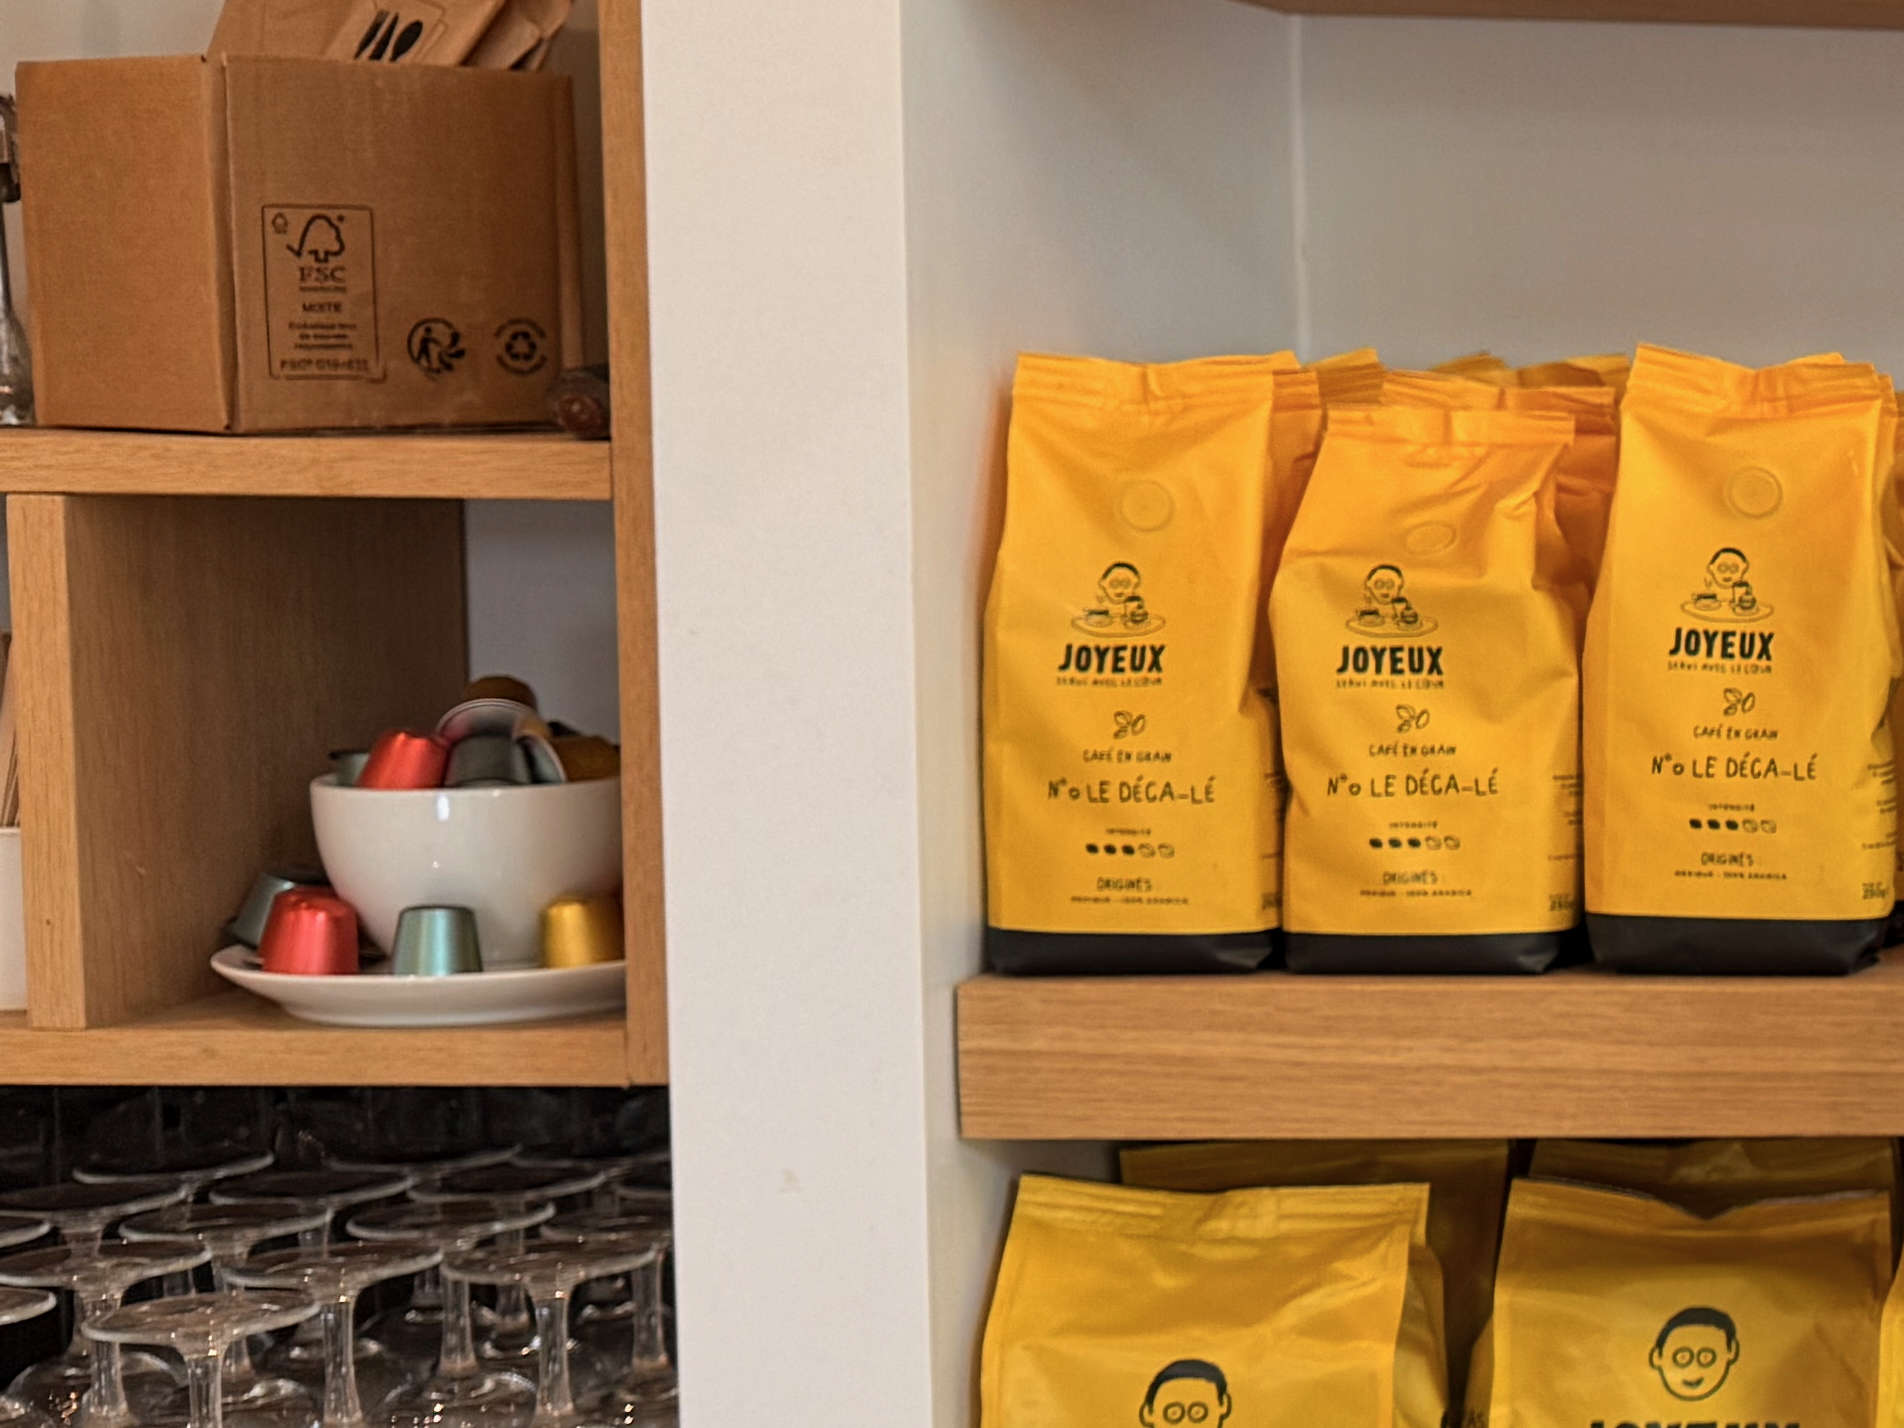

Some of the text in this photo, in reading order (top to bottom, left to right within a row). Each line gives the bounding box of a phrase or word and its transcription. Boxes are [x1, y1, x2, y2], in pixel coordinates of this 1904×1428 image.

[1058, 644, 1165, 674] JOYEUX
[1669, 627, 1774, 661] JOYEUX
[1086, 775, 1216, 805] LE DÉCA-LÉ
